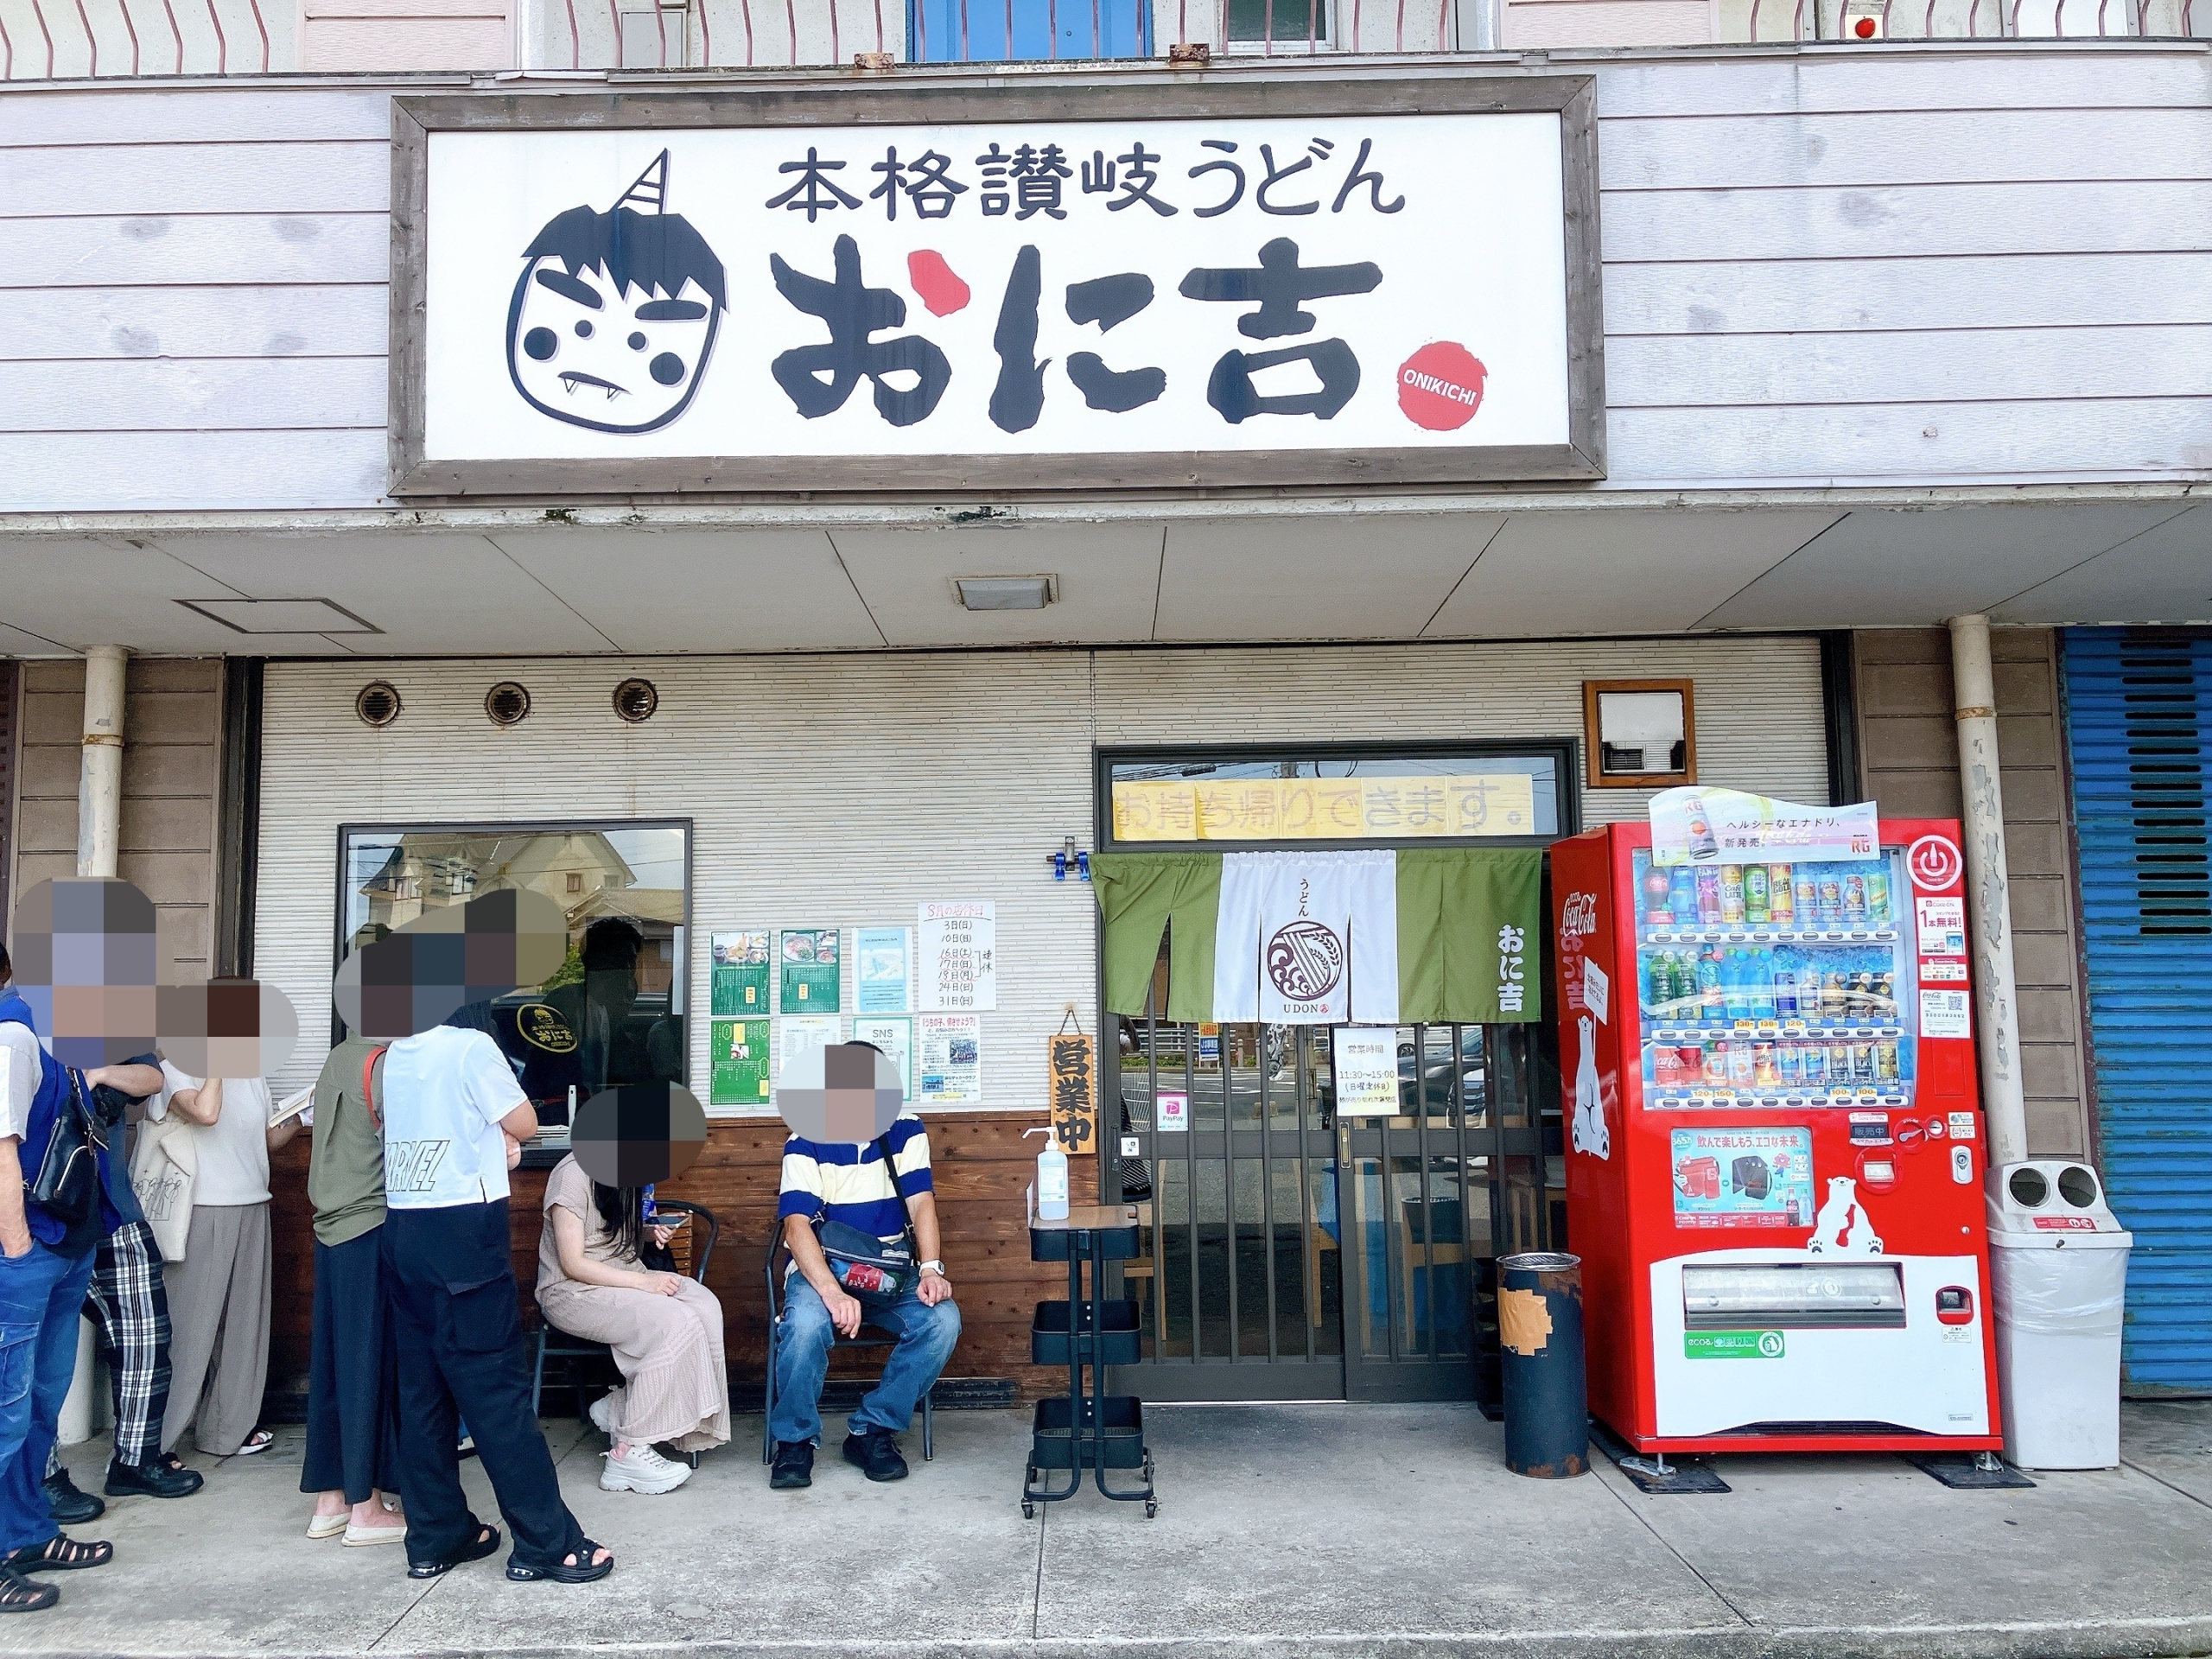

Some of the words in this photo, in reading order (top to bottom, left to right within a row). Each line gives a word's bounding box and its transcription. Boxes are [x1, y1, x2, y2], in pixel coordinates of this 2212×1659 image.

[765, 139, 1406, 221] 本格讃岐うどん
[768, 232, 1384, 434] おに吉
[1402, 367, 1478, 406] ONIKICHI
[1117, 778, 1522, 830] お持ち帰りできます。
[1726, 817, 1840, 830] ヘルシーなエナドリ、
[1724, 837, 1768, 849] 新発売。
[1850, 839, 1872, 854] RG
[1298, 878, 1310, 918] うどん
[1562, 893, 1597, 937] Coca-Cola
[944, 920, 973, 931] 3日(日)
[941, 934, 973, 944] 10日(日)
[939, 959, 973, 969] 17日(日)
[1497, 924, 1525, 1013] おに吉
[938, 995, 974, 1007] 31日(日)
[1283, 1004, 1319, 1014] UDON
[872, 1028, 893, 1039] SNS
[1347, 1044, 1384, 1055] 営業時間
[1338, 1071, 1395, 1079] 11:30～15:00
[1344, 1081, 1390, 1092] (日曜定休日)
[1052, 1039, 1092, 1152] 営業中
[1853, 1127, 1885, 1135] 販売中
[1696, 1135, 1803, 1148] 飲んで楽しもう、エコな未来。
